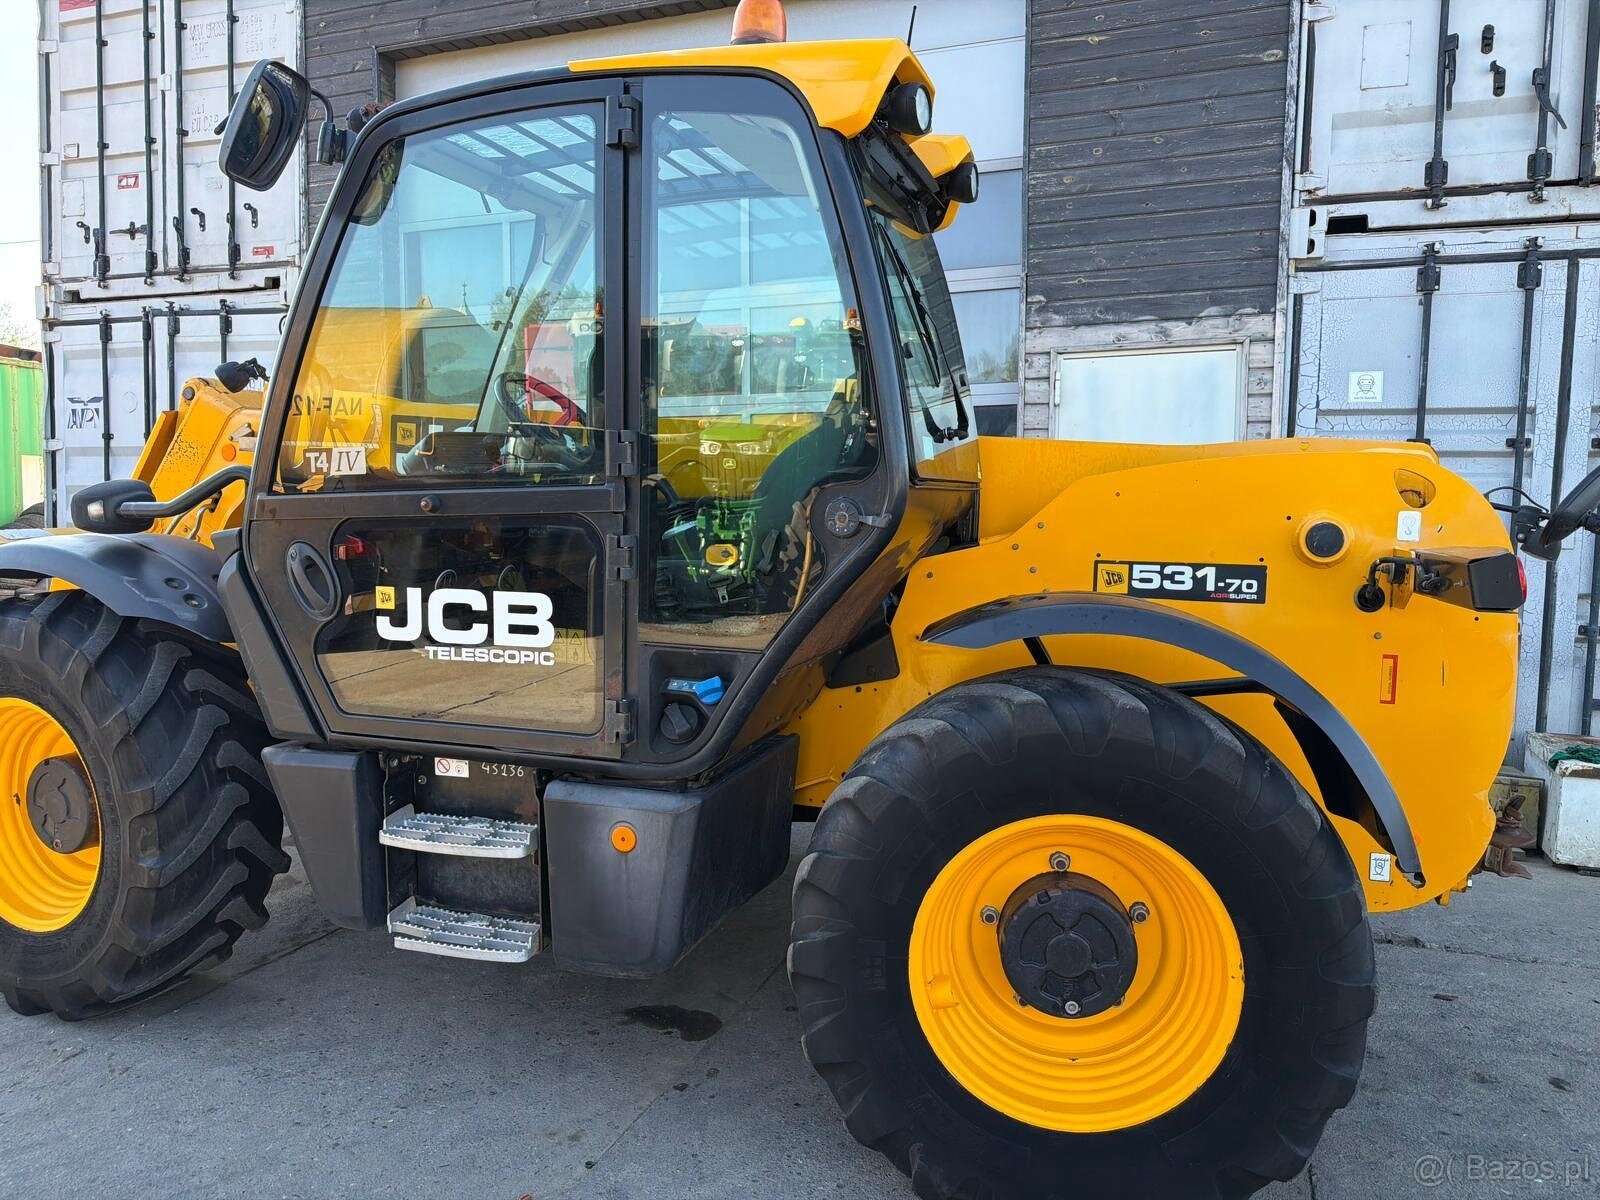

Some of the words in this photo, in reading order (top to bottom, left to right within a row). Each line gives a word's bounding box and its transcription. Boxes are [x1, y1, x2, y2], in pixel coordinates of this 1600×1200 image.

[305, 451, 329, 473] T4
[335, 450, 361, 472] IV
[1101, 568, 1124, 588] JCB
[1131, 564, 1258, 593] 531-70
[1210, 592, 1258, 600] AGRISUPER
[375, 586, 555, 648] JCB
[424, 645, 556, 666] TELESCOPIC
